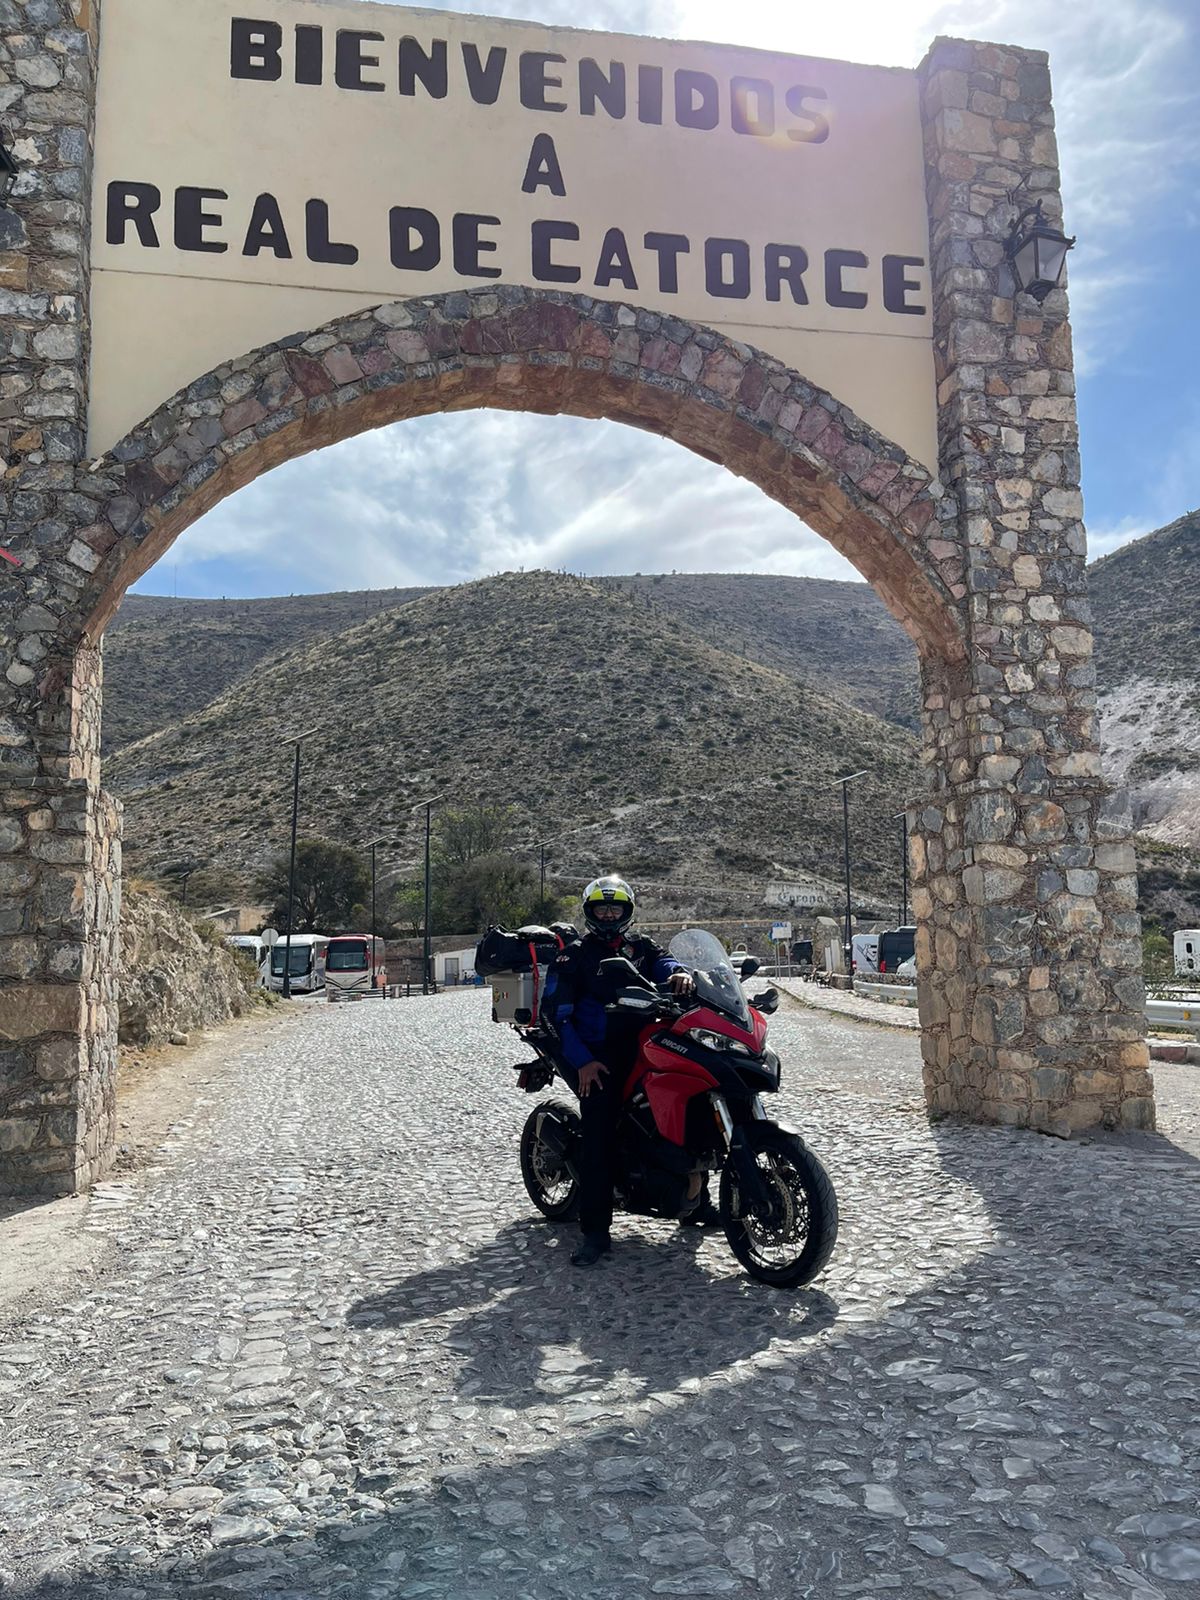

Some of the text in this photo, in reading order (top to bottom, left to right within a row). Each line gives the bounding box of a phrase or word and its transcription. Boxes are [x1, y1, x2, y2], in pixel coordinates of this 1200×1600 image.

[230, 16, 830, 144] BIENVENIDOS
[521, 132, 567, 197] A
[105, 179, 929, 317] REAL DE CATORCE
[778, 891, 824, 905] Corona
[660, 1038, 689, 1054] DUCATI
